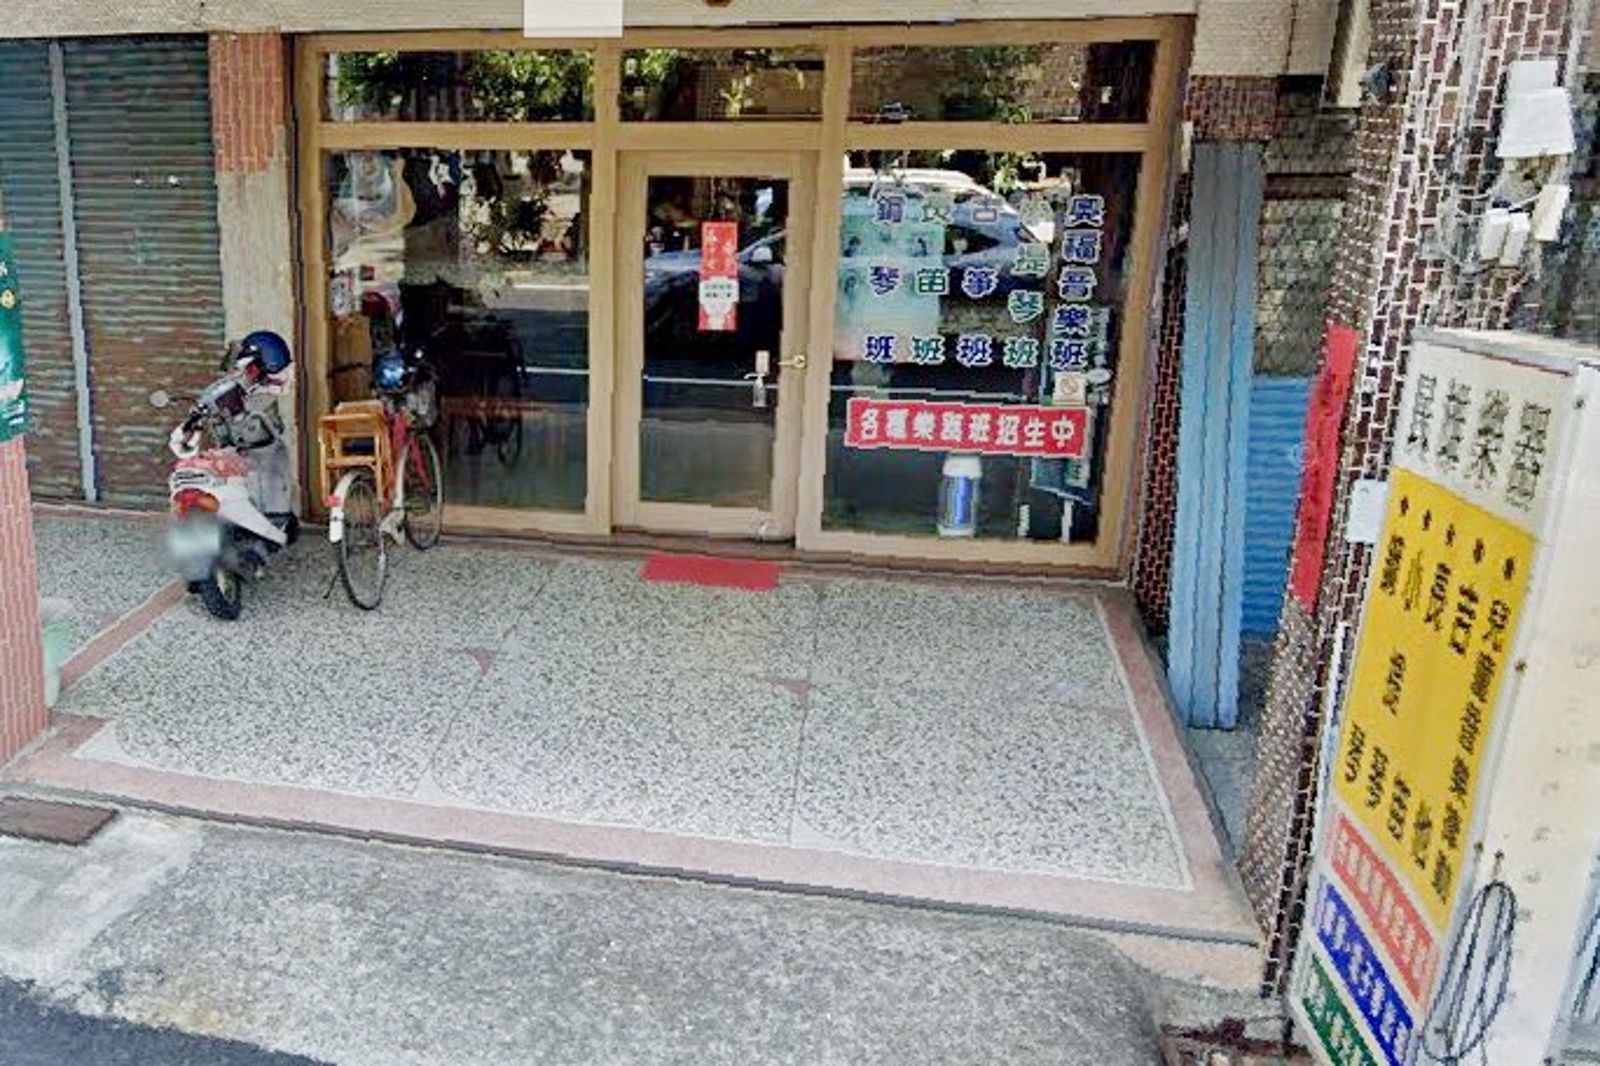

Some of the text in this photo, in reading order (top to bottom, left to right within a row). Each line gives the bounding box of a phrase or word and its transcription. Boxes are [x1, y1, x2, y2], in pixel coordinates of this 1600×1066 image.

[1050, 195, 1105, 367] 奧福音樂班
